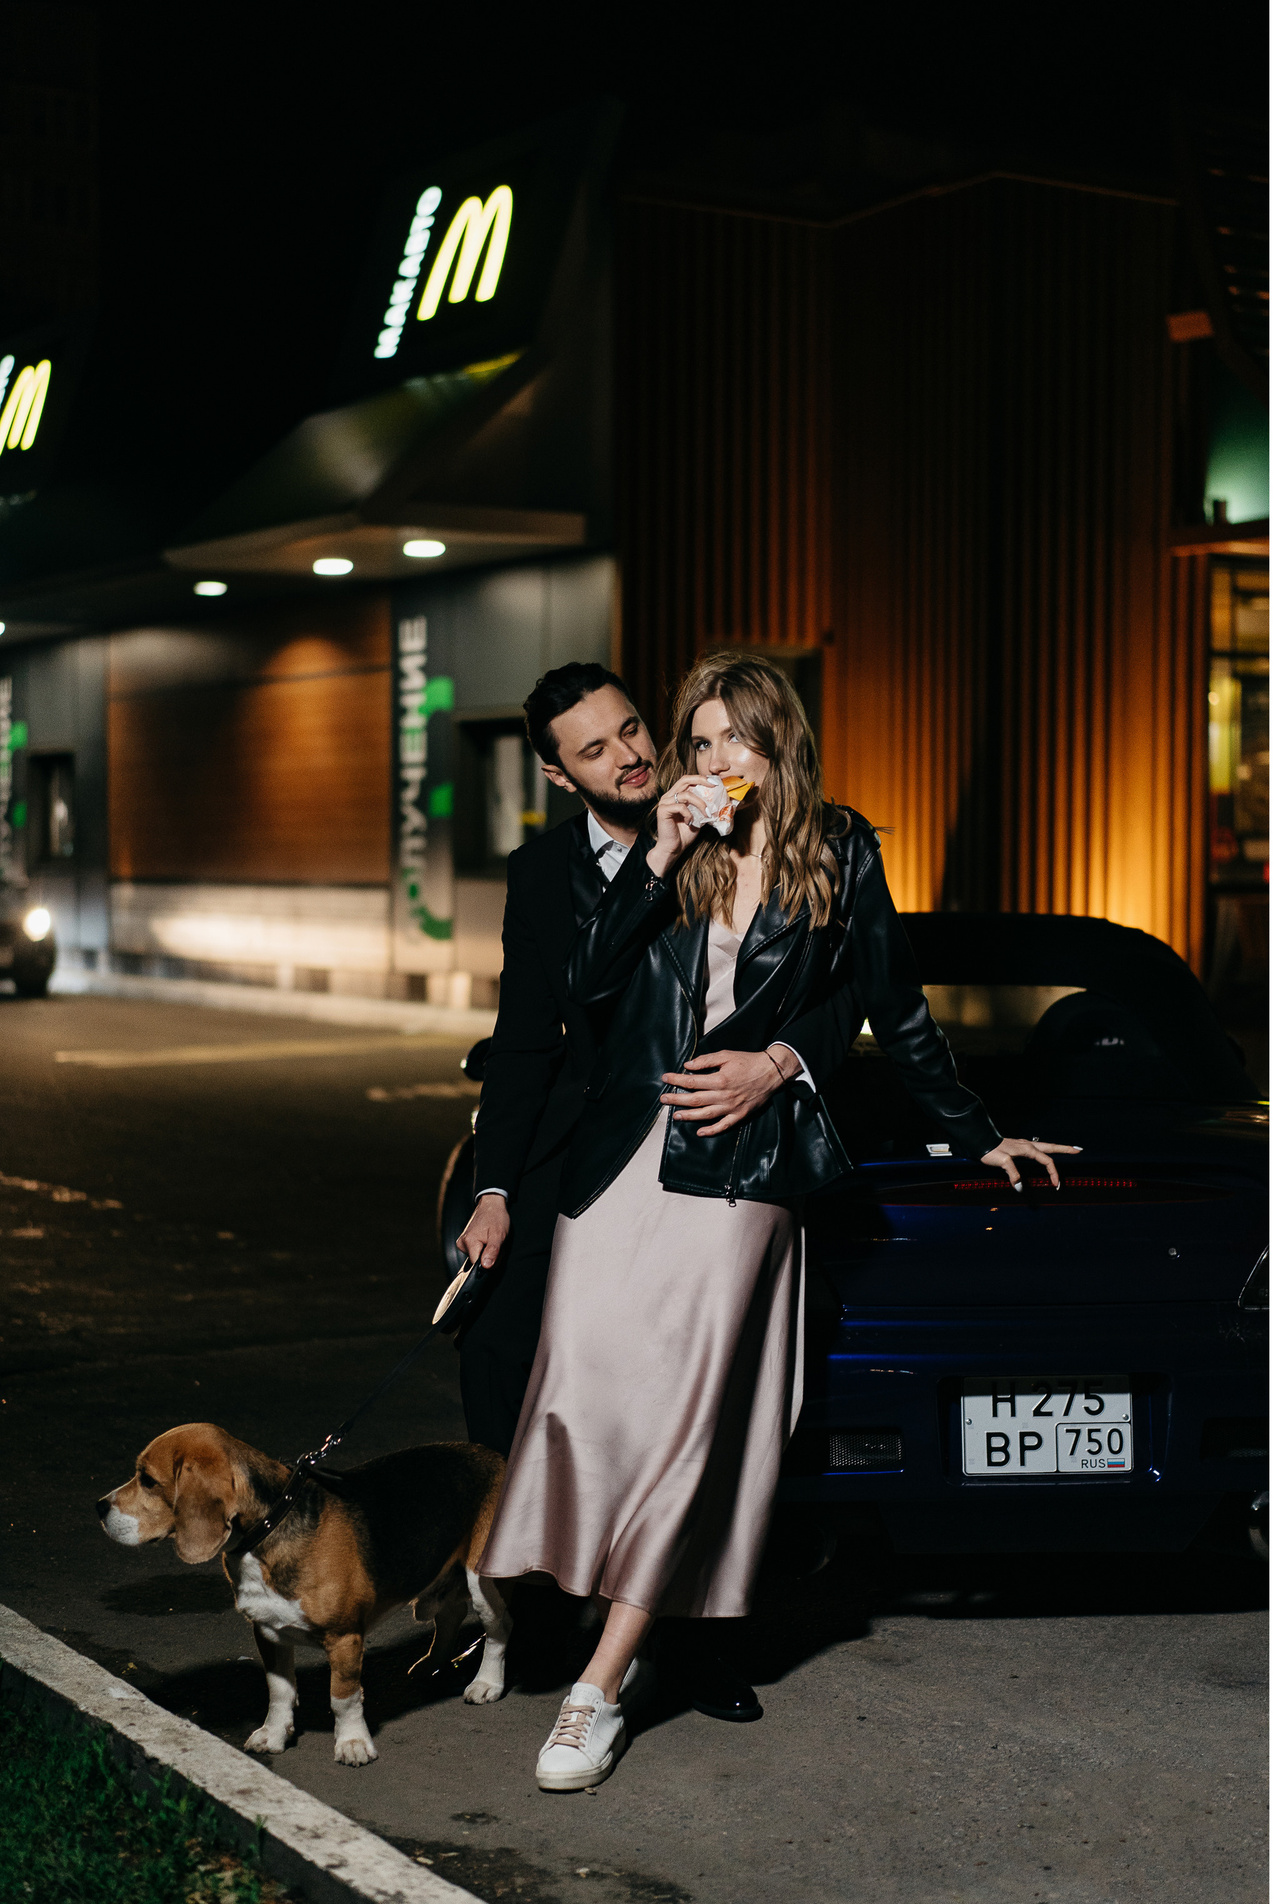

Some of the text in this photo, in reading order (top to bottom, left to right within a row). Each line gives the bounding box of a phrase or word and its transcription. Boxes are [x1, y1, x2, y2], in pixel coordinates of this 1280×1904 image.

[1032, 1380, 1105, 1417] 275
[1065, 1428, 1124, 1456] 750
[1081, 1458, 1106, 1469] RUS
